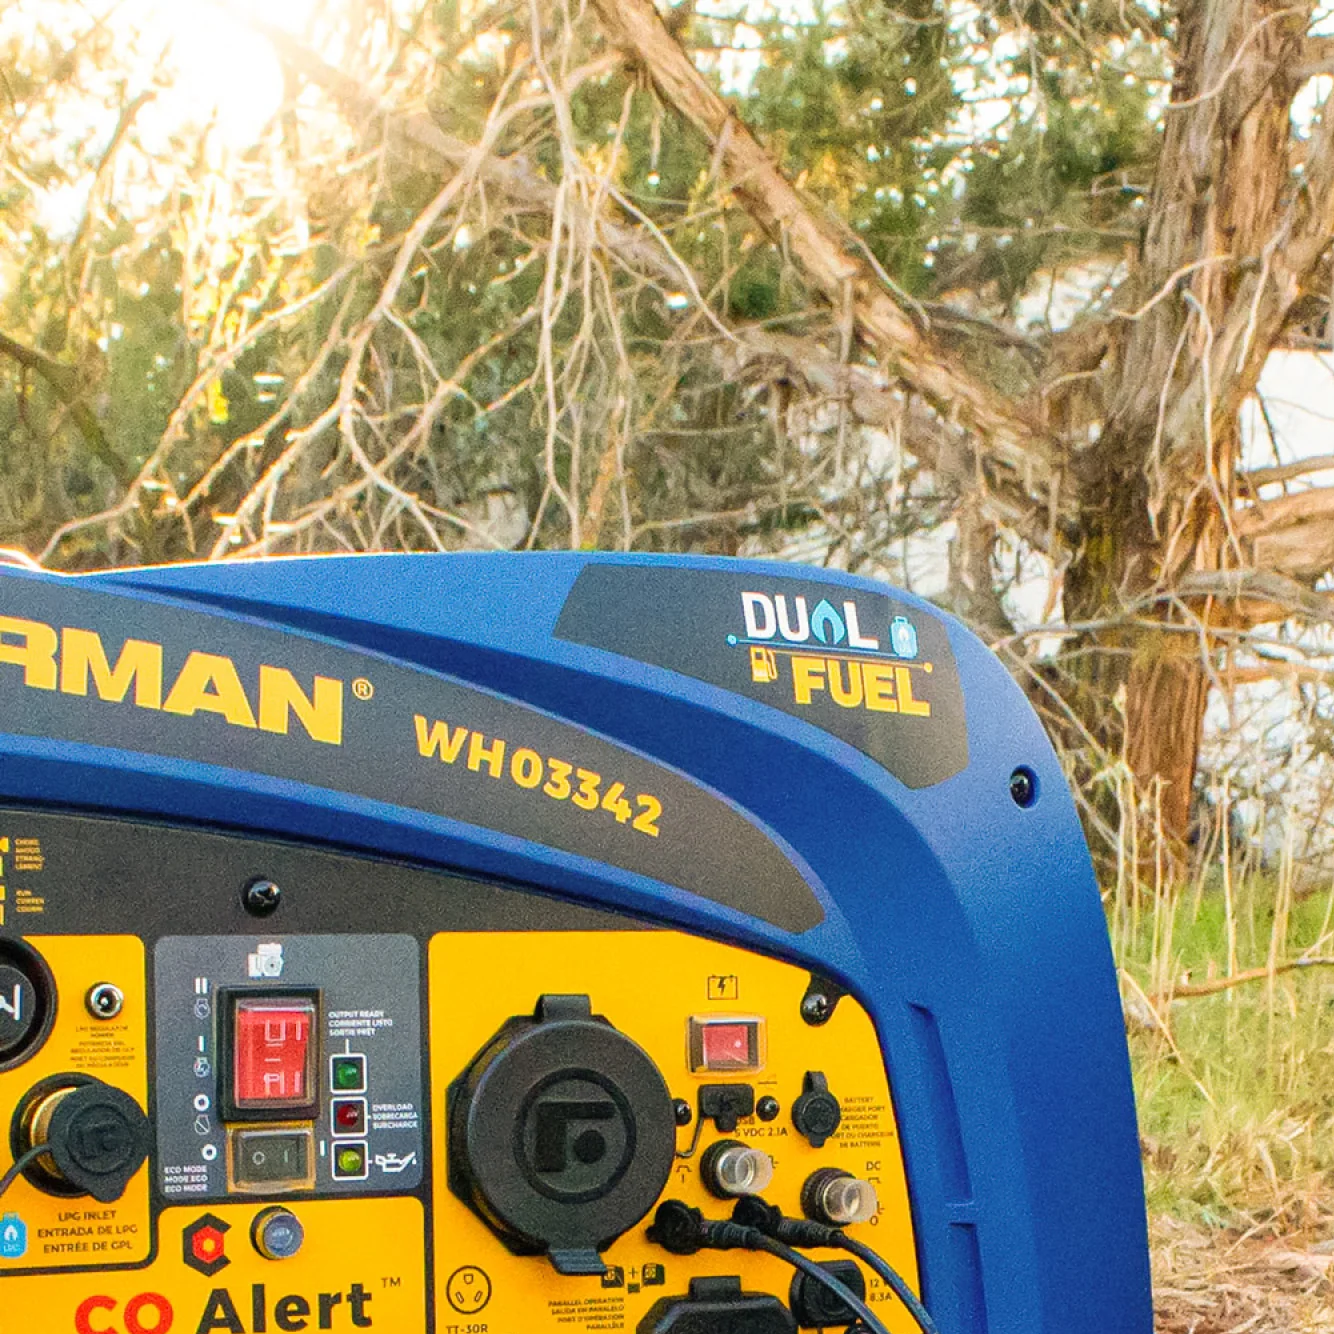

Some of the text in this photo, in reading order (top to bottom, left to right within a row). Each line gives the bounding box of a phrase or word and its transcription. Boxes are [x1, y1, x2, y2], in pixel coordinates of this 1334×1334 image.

[740, 591, 880, 650] DUAL
[790, 656, 932, 718] FUEL
[413, 713, 663, 838] WH03342
[743, 1127, 765, 1137] VDC
[866, 1160, 881, 1171] DC
[58, 1209, 117, 1222] LPG INLET
[37, 1223, 138, 1238] ENTRADA DE LPG
[43, 1241, 89, 1254] ENTRÉE
[92, 1240, 108, 1251] DE
[870, 1279, 880, 1288] 12
